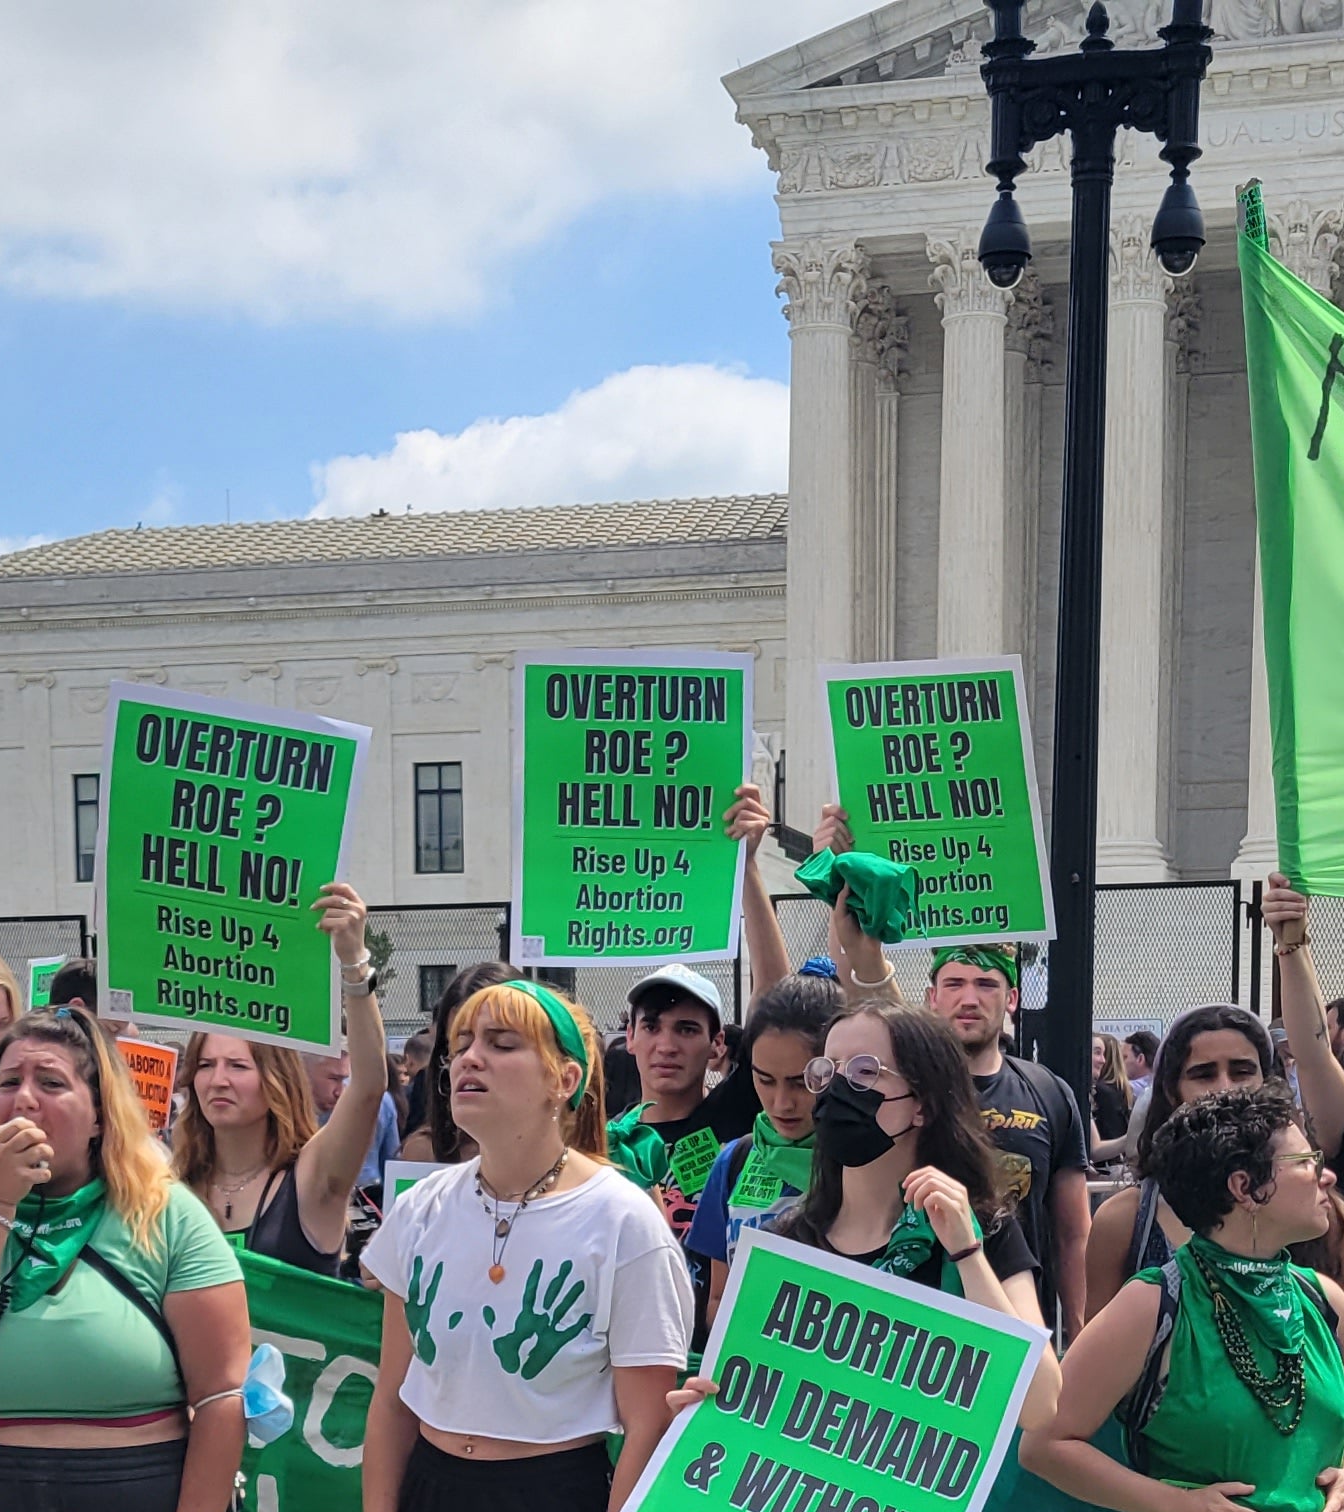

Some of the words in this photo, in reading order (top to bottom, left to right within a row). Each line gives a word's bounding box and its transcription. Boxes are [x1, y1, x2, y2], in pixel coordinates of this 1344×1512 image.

[544, 673, 727, 723] OVERTURN
[844, 679, 1003, 729] OVERTURN
[135, 712, 337, 795] OVERTURN
[584, 730, 654, 776] ROE
[664, 731, 689, 776] ?
[881, 732, 945, 776] ROE
[949, 731, 972, 773] ?
[170, 779, 246, 840] ROE
[252, 793, 284, 844] ?
[557, 782, 641, 828] HELL
[653, 784, 713, 831] NO!
[866, 779, 943, 824] HELL
[948, 777, 1006, 820] NO!
[140, 834, 228, 896] HELL
[239, 848, 304, 908] NO!
[572, 845, 626, 875] Rise
[633, 847, 667, 882] Up
[673, 848, 691, 877] 4
[887, 837, 938, 864] Rise
[941, 835, 972, 866] Up
[976, 834, 993, 859] 4
[575, 883, 684, 913] Abortion
[157, 905, 213, 941] Rise
[220, 915, 255, 952] Up
[261, 923, 281, 952] 4
[567, 919, 693, 954] Rights.org
[162, 943, 277, 988] Abortion
[157, 978, 291, 1032] Rights.org
[761, 1280, 991, 1411] ABORTION
[714, 1354, 784, 1428] ON
[780, 1380, 983, 1502] DEMAND
[683, 1441, 727, 1494] &
